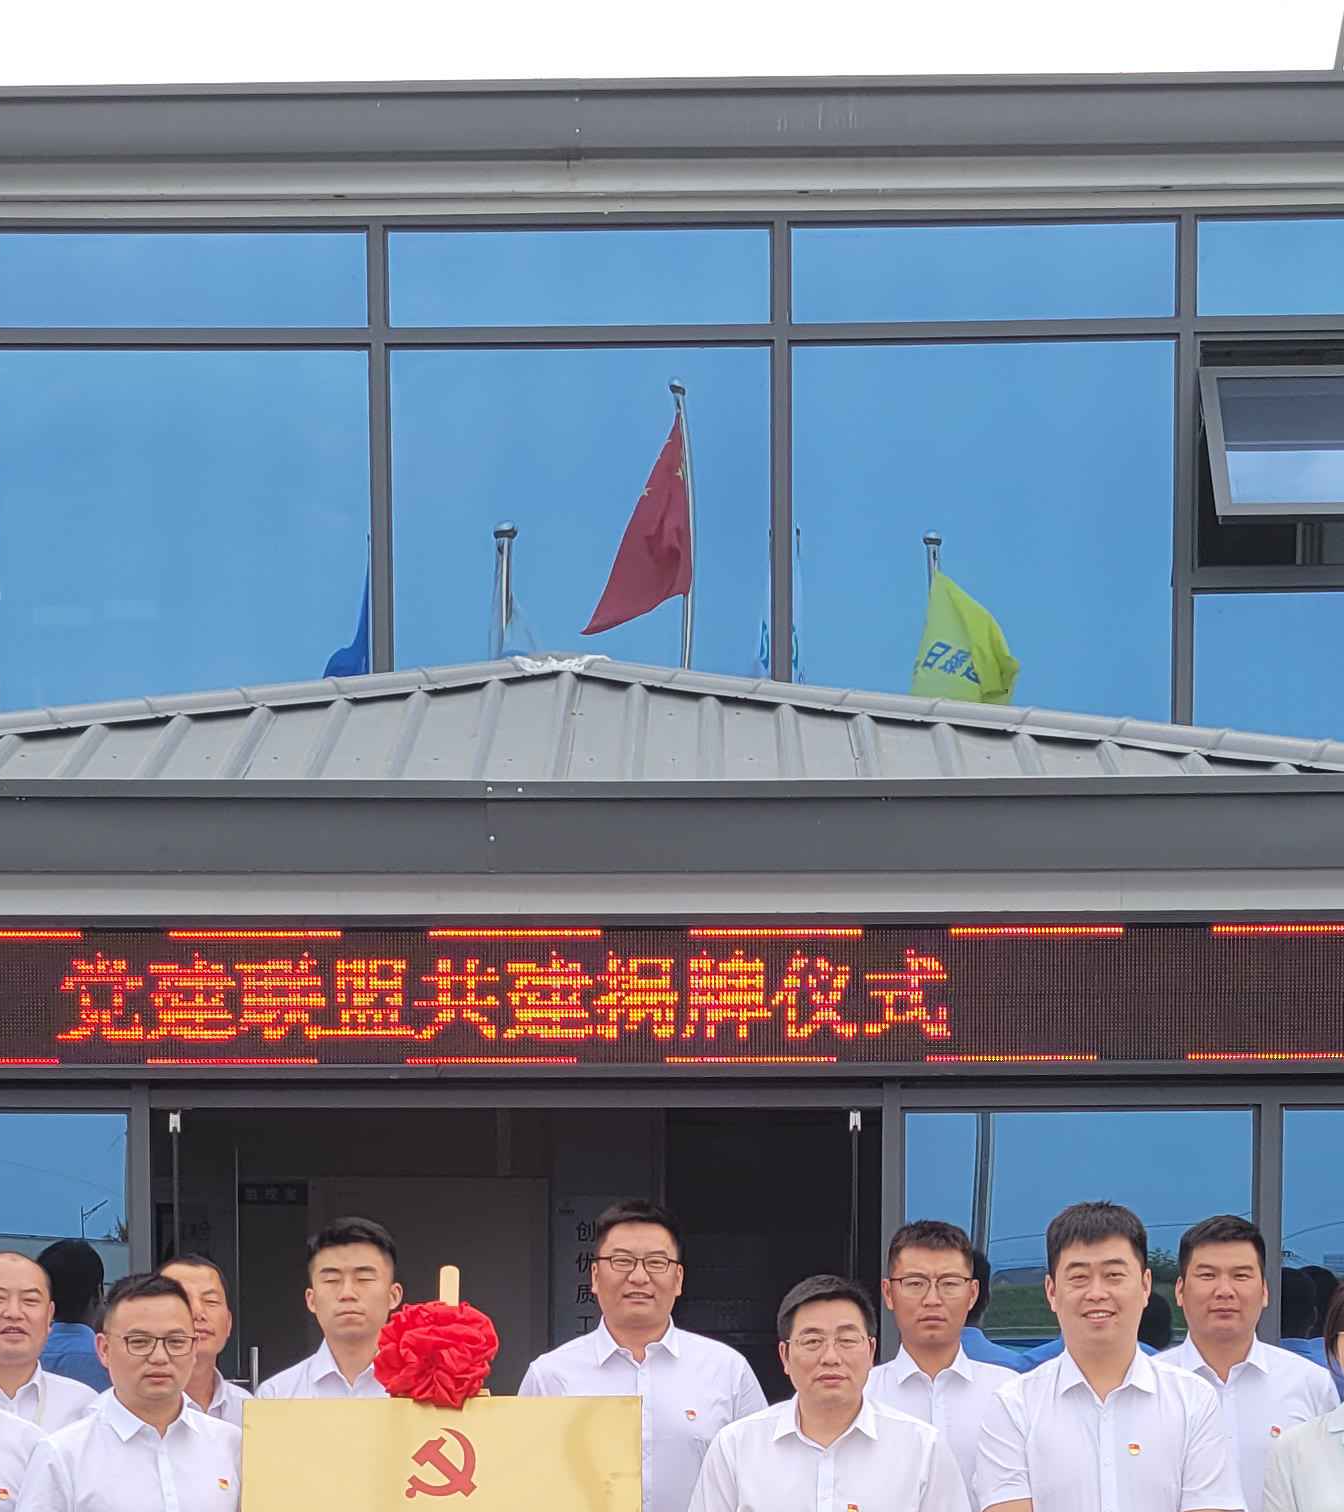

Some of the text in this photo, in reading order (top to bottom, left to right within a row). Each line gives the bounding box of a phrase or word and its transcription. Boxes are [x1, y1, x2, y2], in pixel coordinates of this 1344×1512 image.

[57, 950, 952, 1042] 党建联盟共建揭牌仪式
